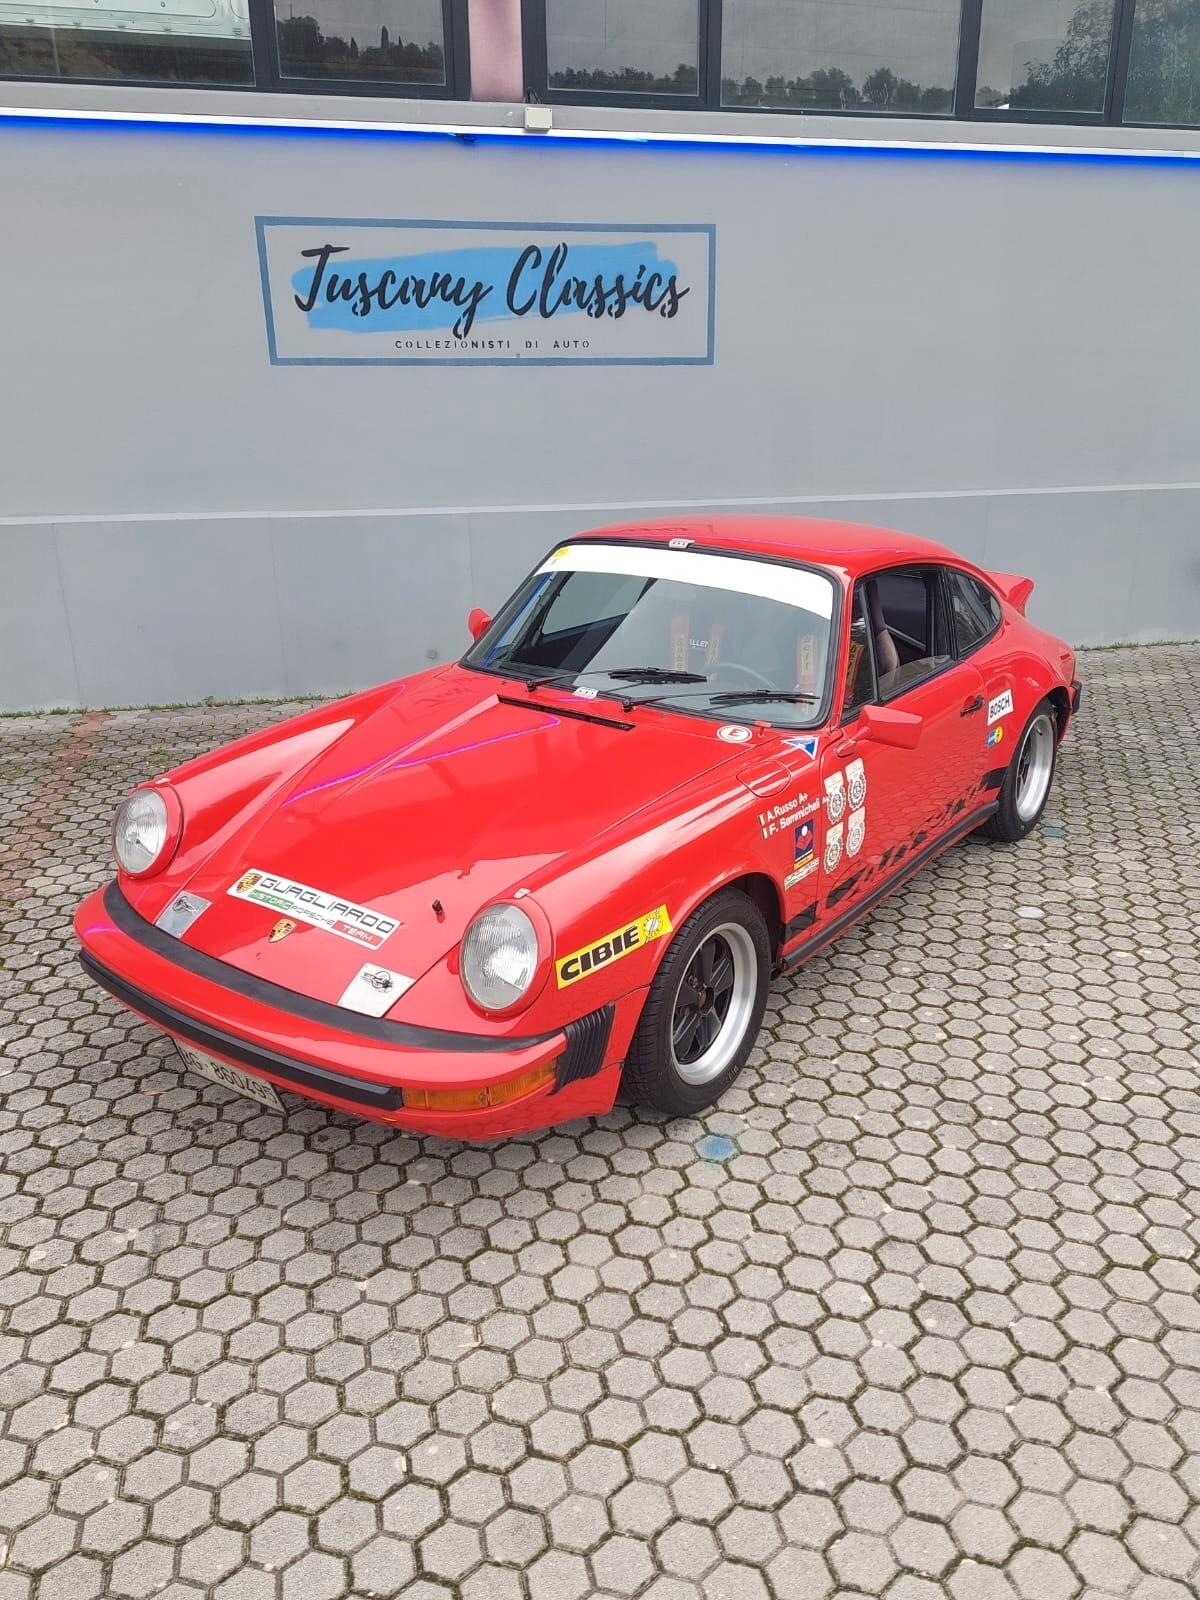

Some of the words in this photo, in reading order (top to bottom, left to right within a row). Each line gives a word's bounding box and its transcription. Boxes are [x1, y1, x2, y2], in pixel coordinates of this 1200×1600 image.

[294, 244, 493, 340] Tuscany
[506, 242, 690, 319] Classics
[394, 340, 510, 349] COLLEZIONISTI
[525, 340, 539, 349] DI
[553, 340, 591, 349] AUTO
[990, 694, 1011, 719] BOSCH
[260, 877, 396, 934] GUAGLIARDO
[341, 924, 374, 943] TEAM
